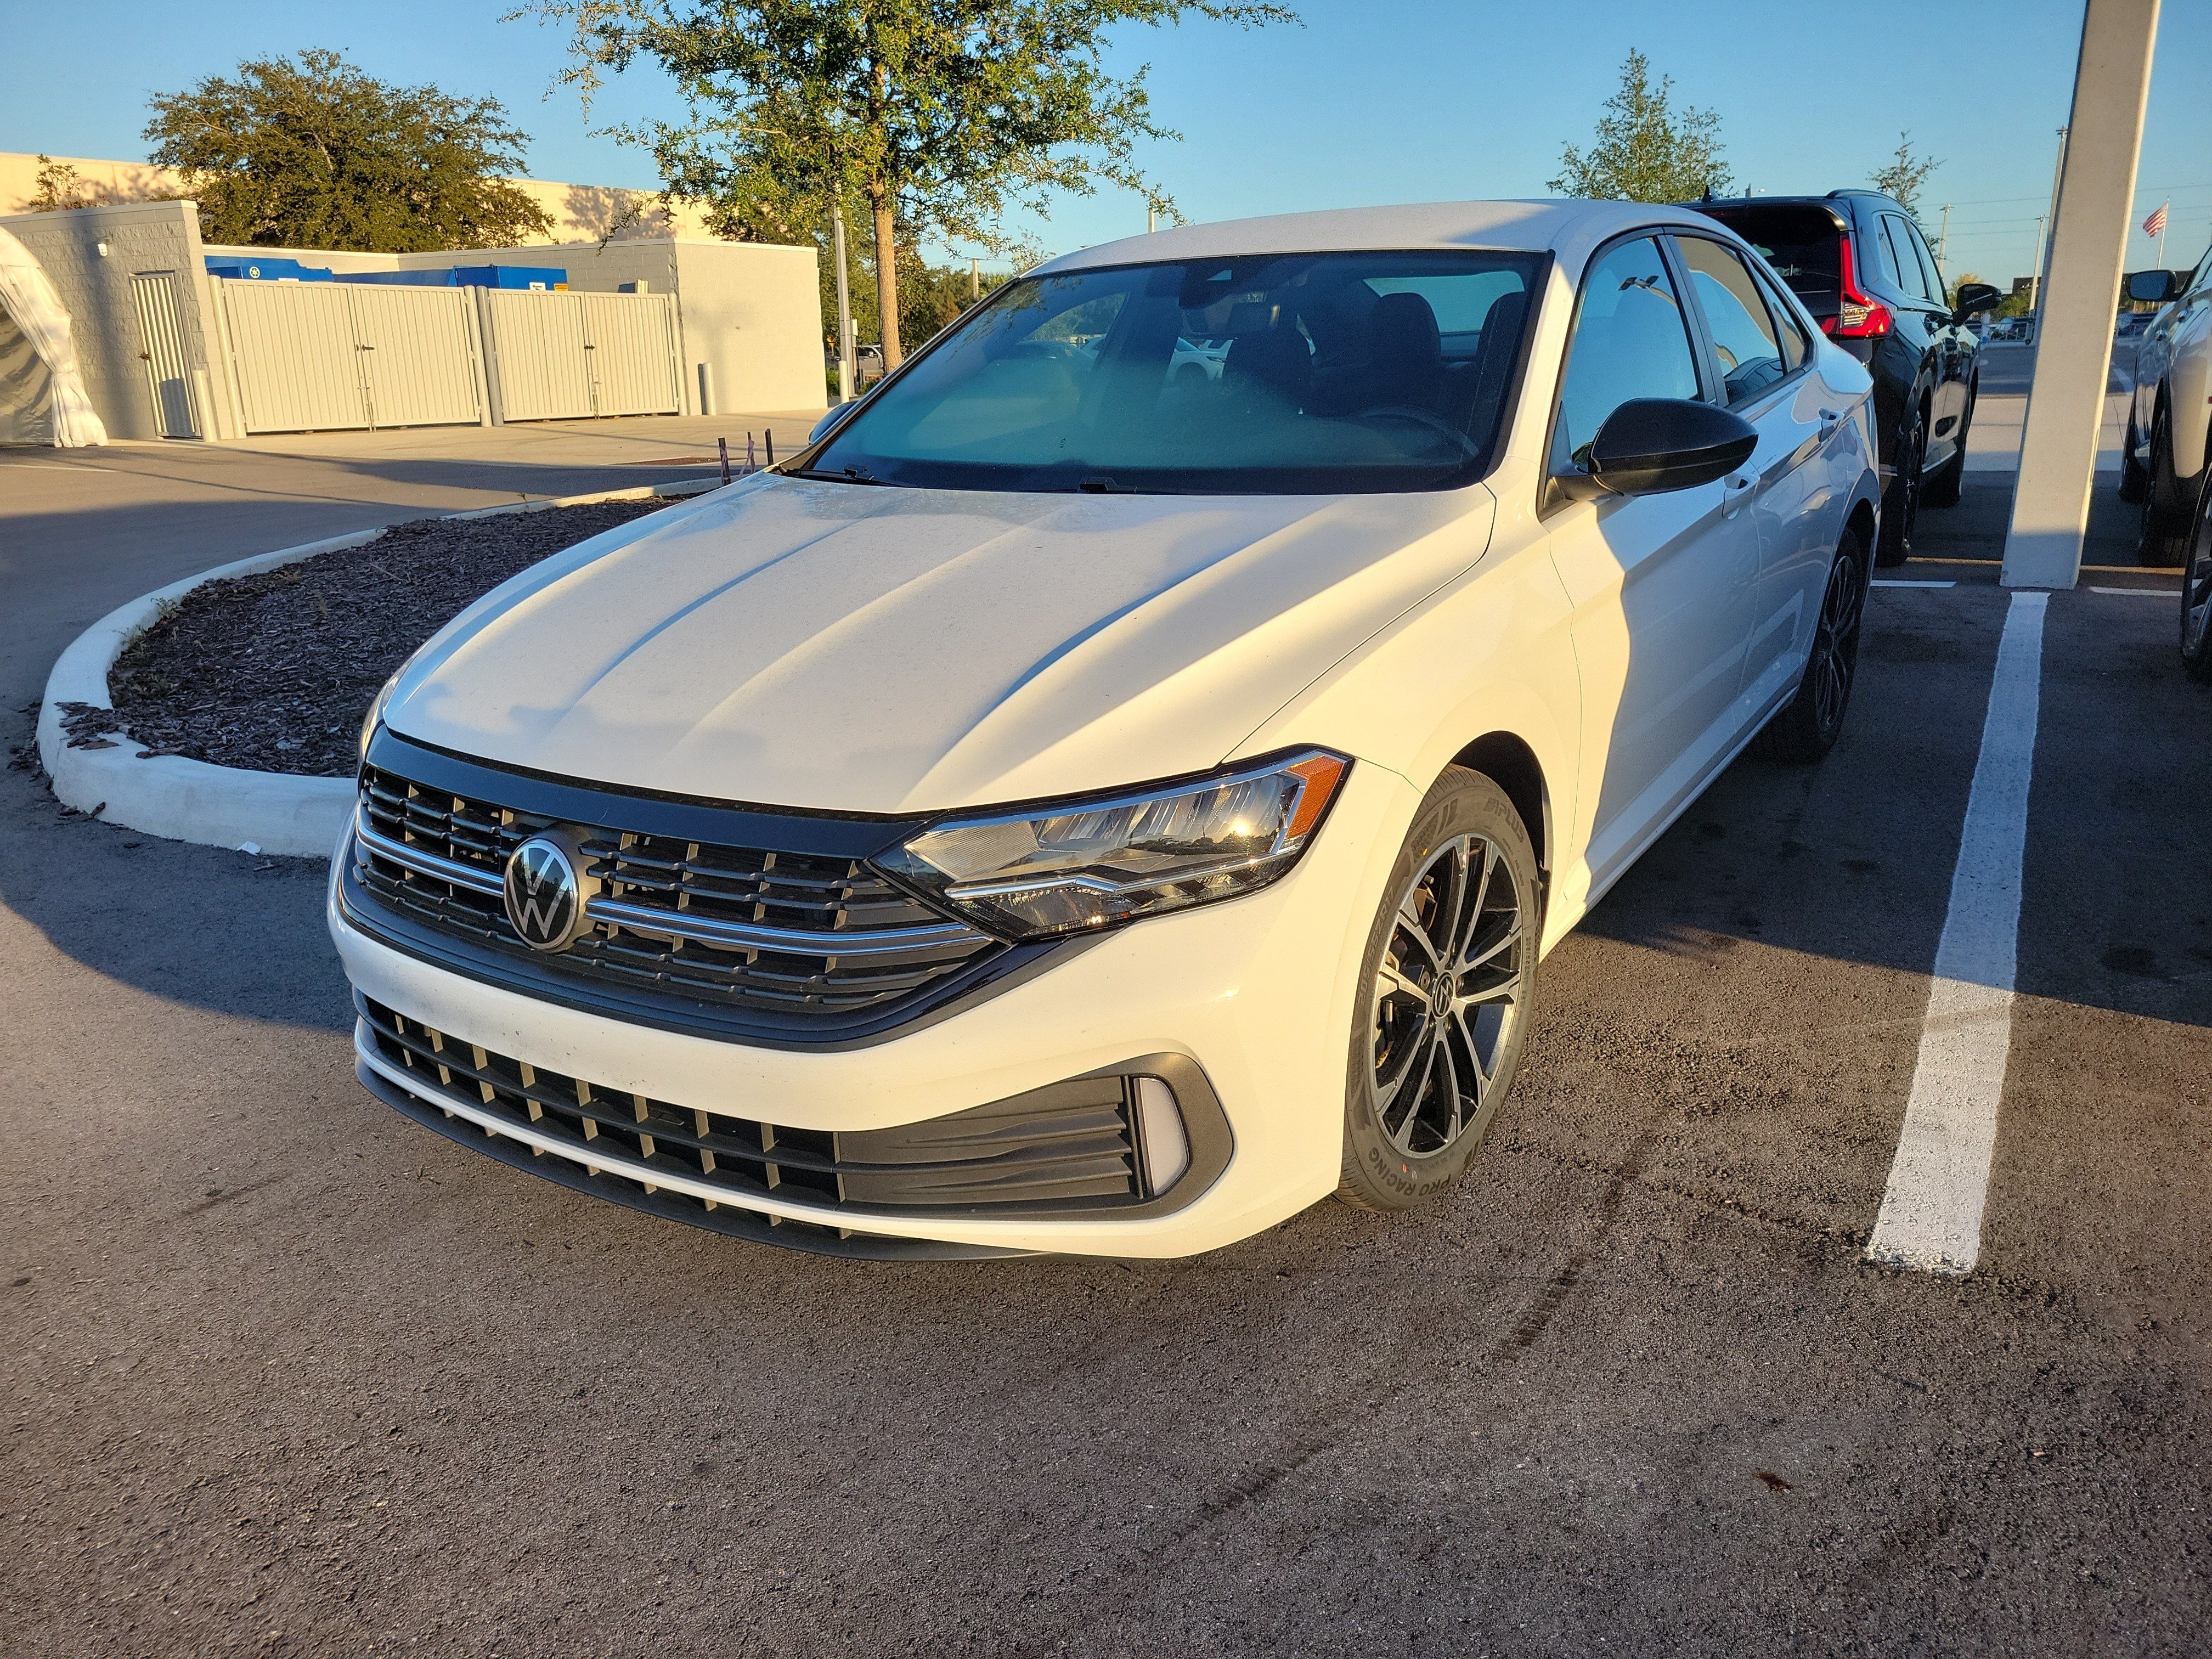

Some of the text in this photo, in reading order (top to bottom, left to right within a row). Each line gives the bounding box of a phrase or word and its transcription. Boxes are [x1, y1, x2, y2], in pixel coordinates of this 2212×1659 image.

[505, 844, 574, 941] VW
[1357, 885, 1395, 1006] 205/55ZR17
[1368, 1147, 1417, 1196] RACING
[1418, 1173, 1451, 1197] PRO
